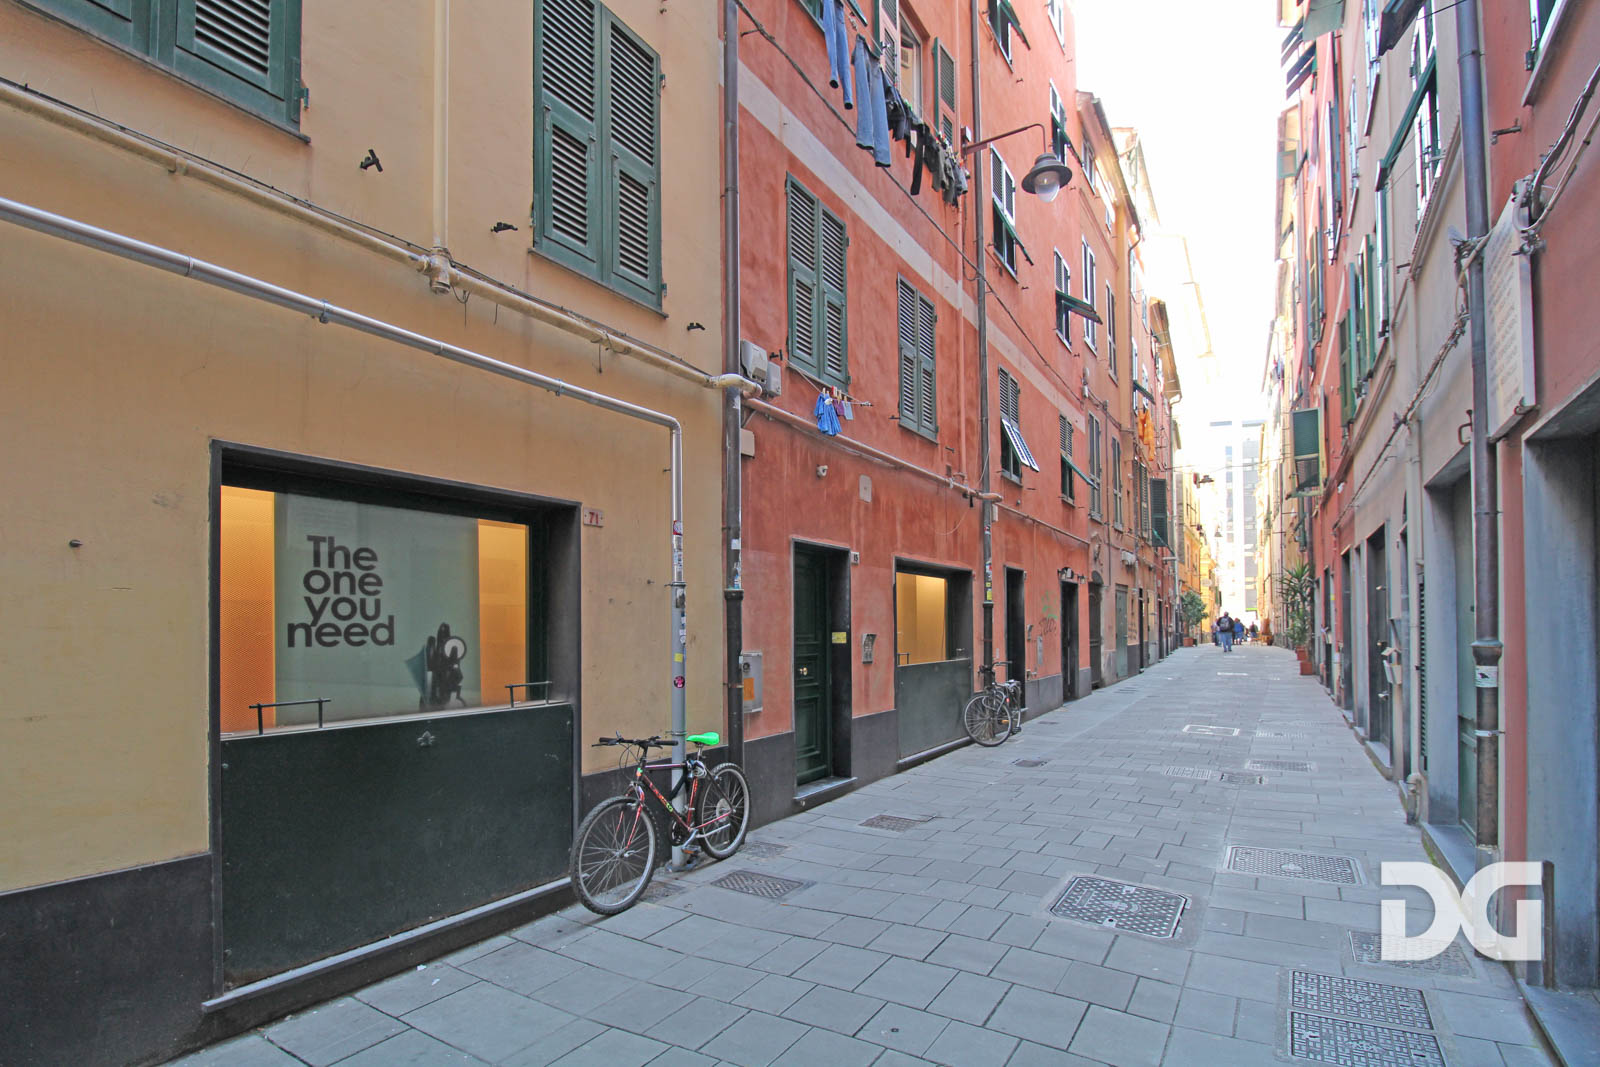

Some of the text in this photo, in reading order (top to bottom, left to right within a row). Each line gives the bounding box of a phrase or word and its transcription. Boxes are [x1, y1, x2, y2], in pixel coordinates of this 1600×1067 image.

[589, 511, 598, 525] 71
[306, 534, 378, 571] The
[303, 569, 383, 597] one
[303, 596, 381, 627] you
[287, 614, 395, 648] need
